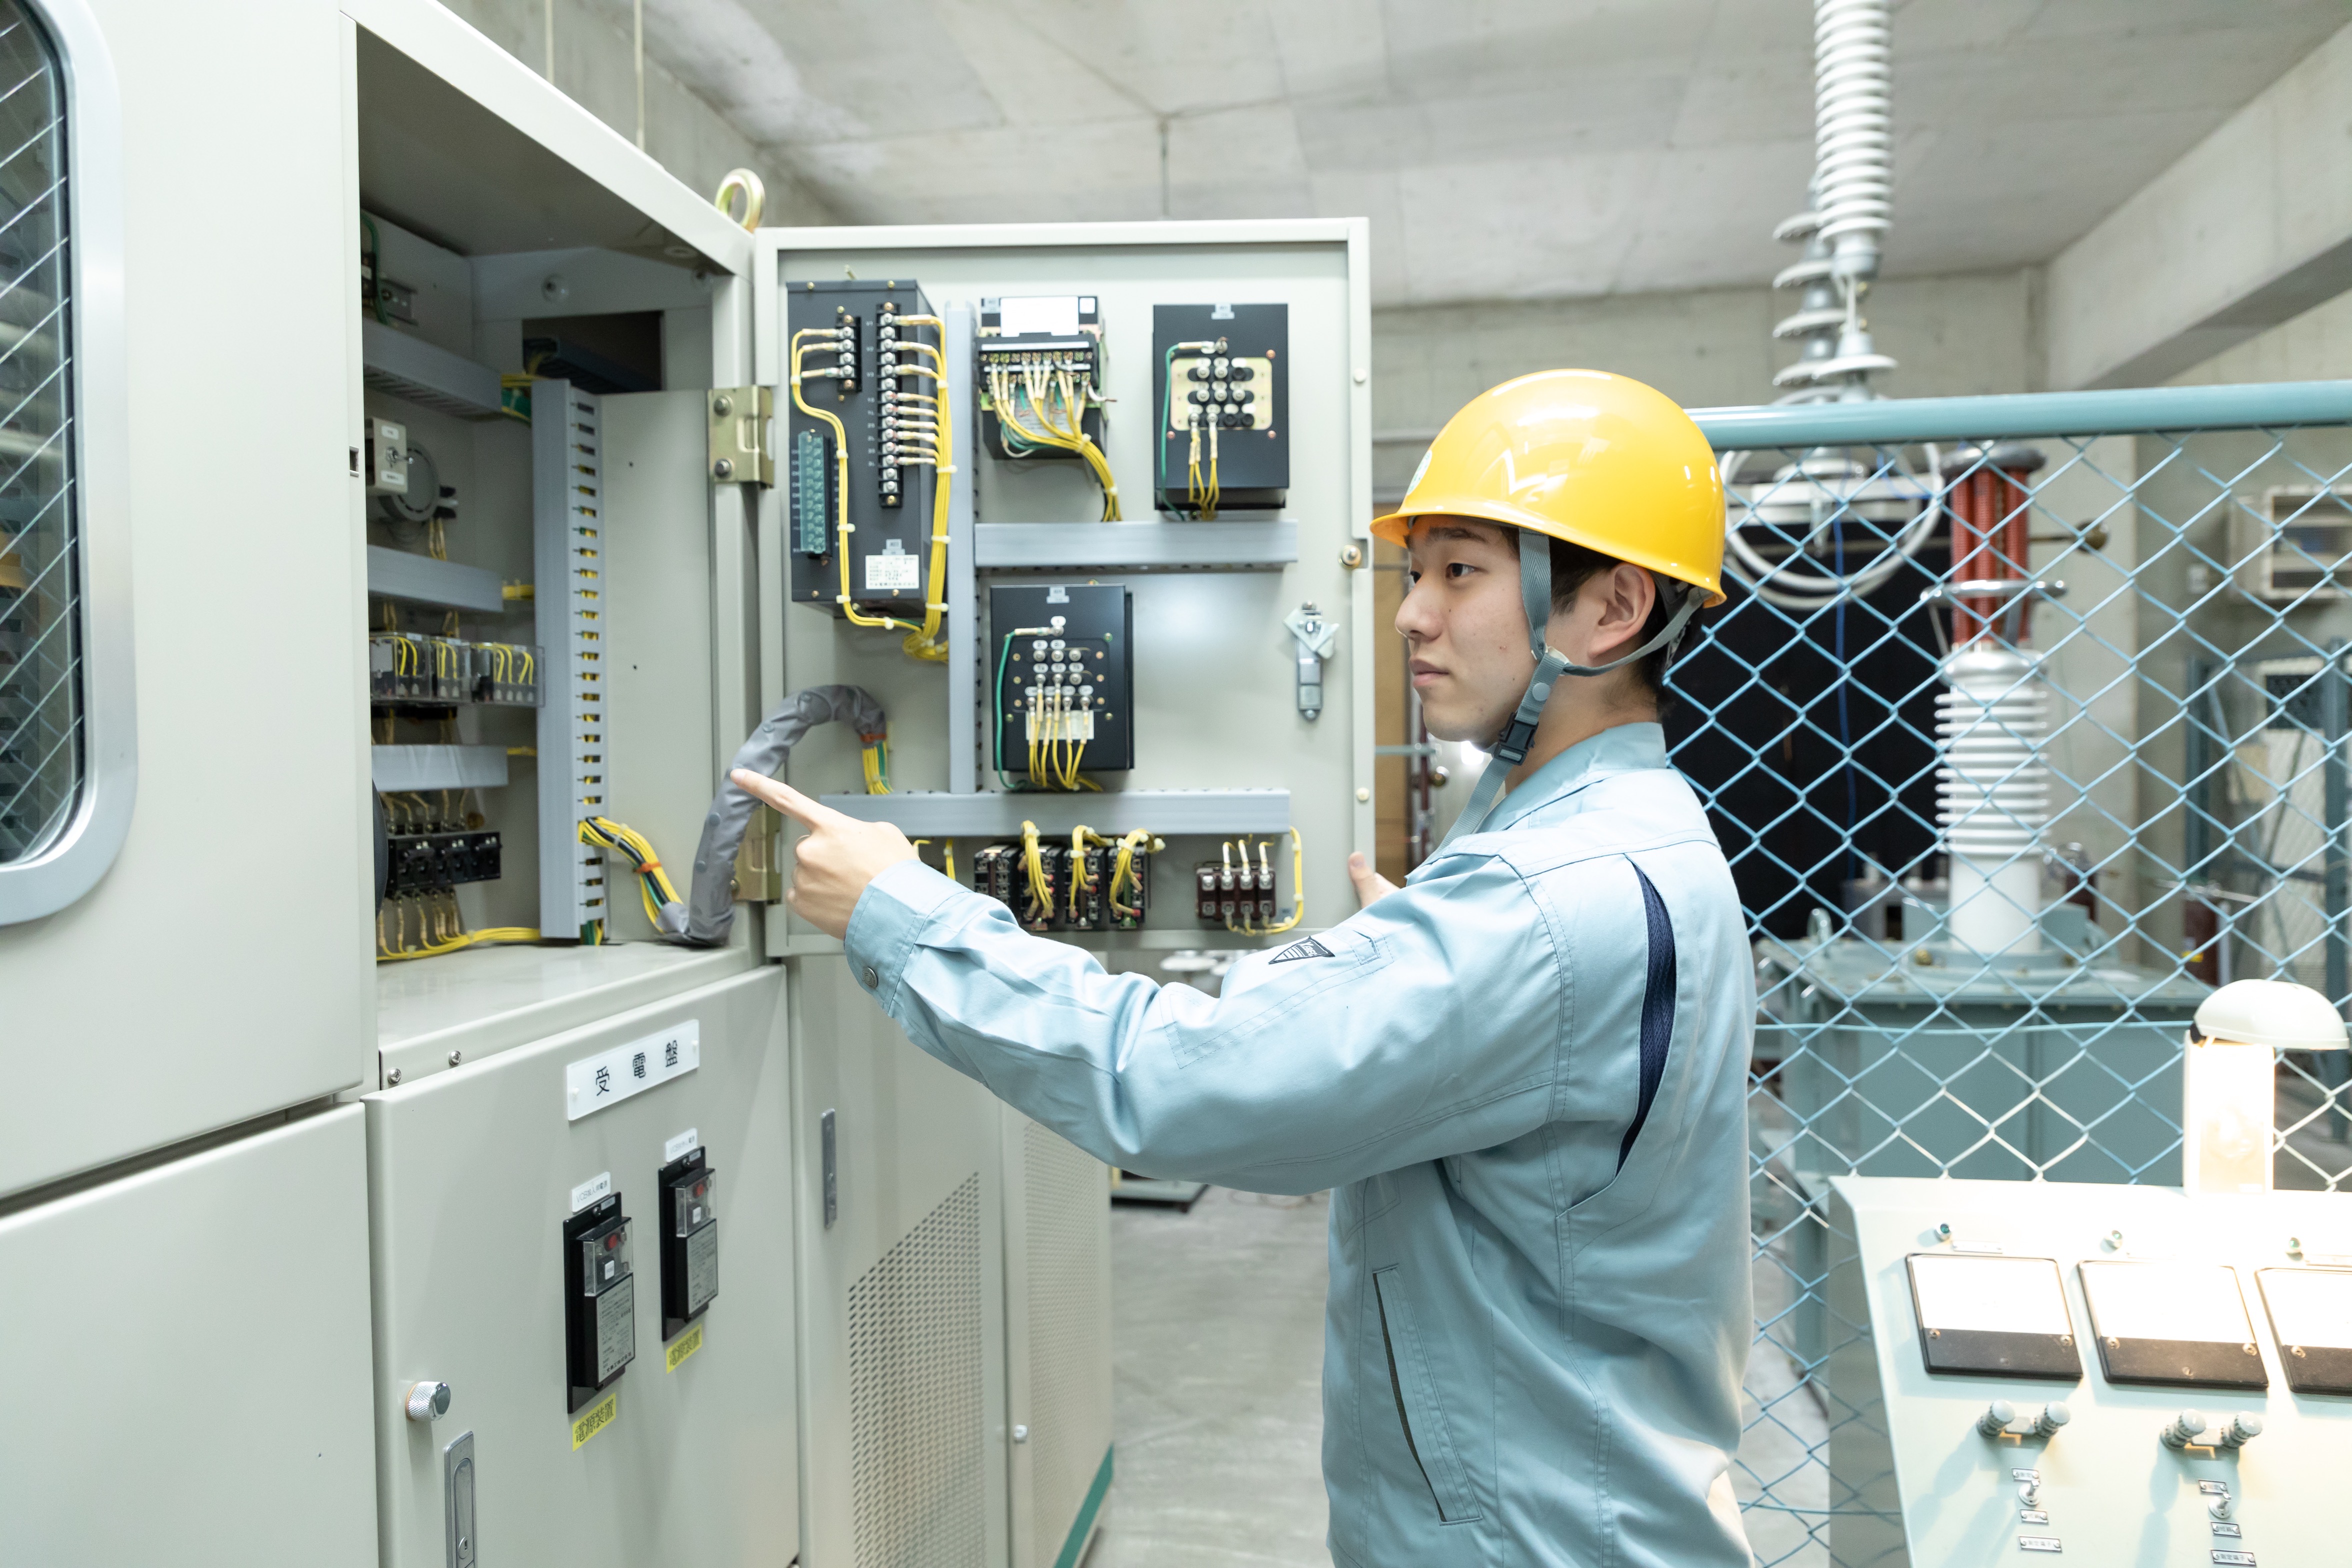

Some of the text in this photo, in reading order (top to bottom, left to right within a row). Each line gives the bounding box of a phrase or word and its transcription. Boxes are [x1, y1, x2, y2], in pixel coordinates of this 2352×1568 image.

[1298, 942, 1318, 956] XEBEC
[596, 1040, 678, 1096] 受電盤
[575, 1399, 614, 1442] 電源装置
